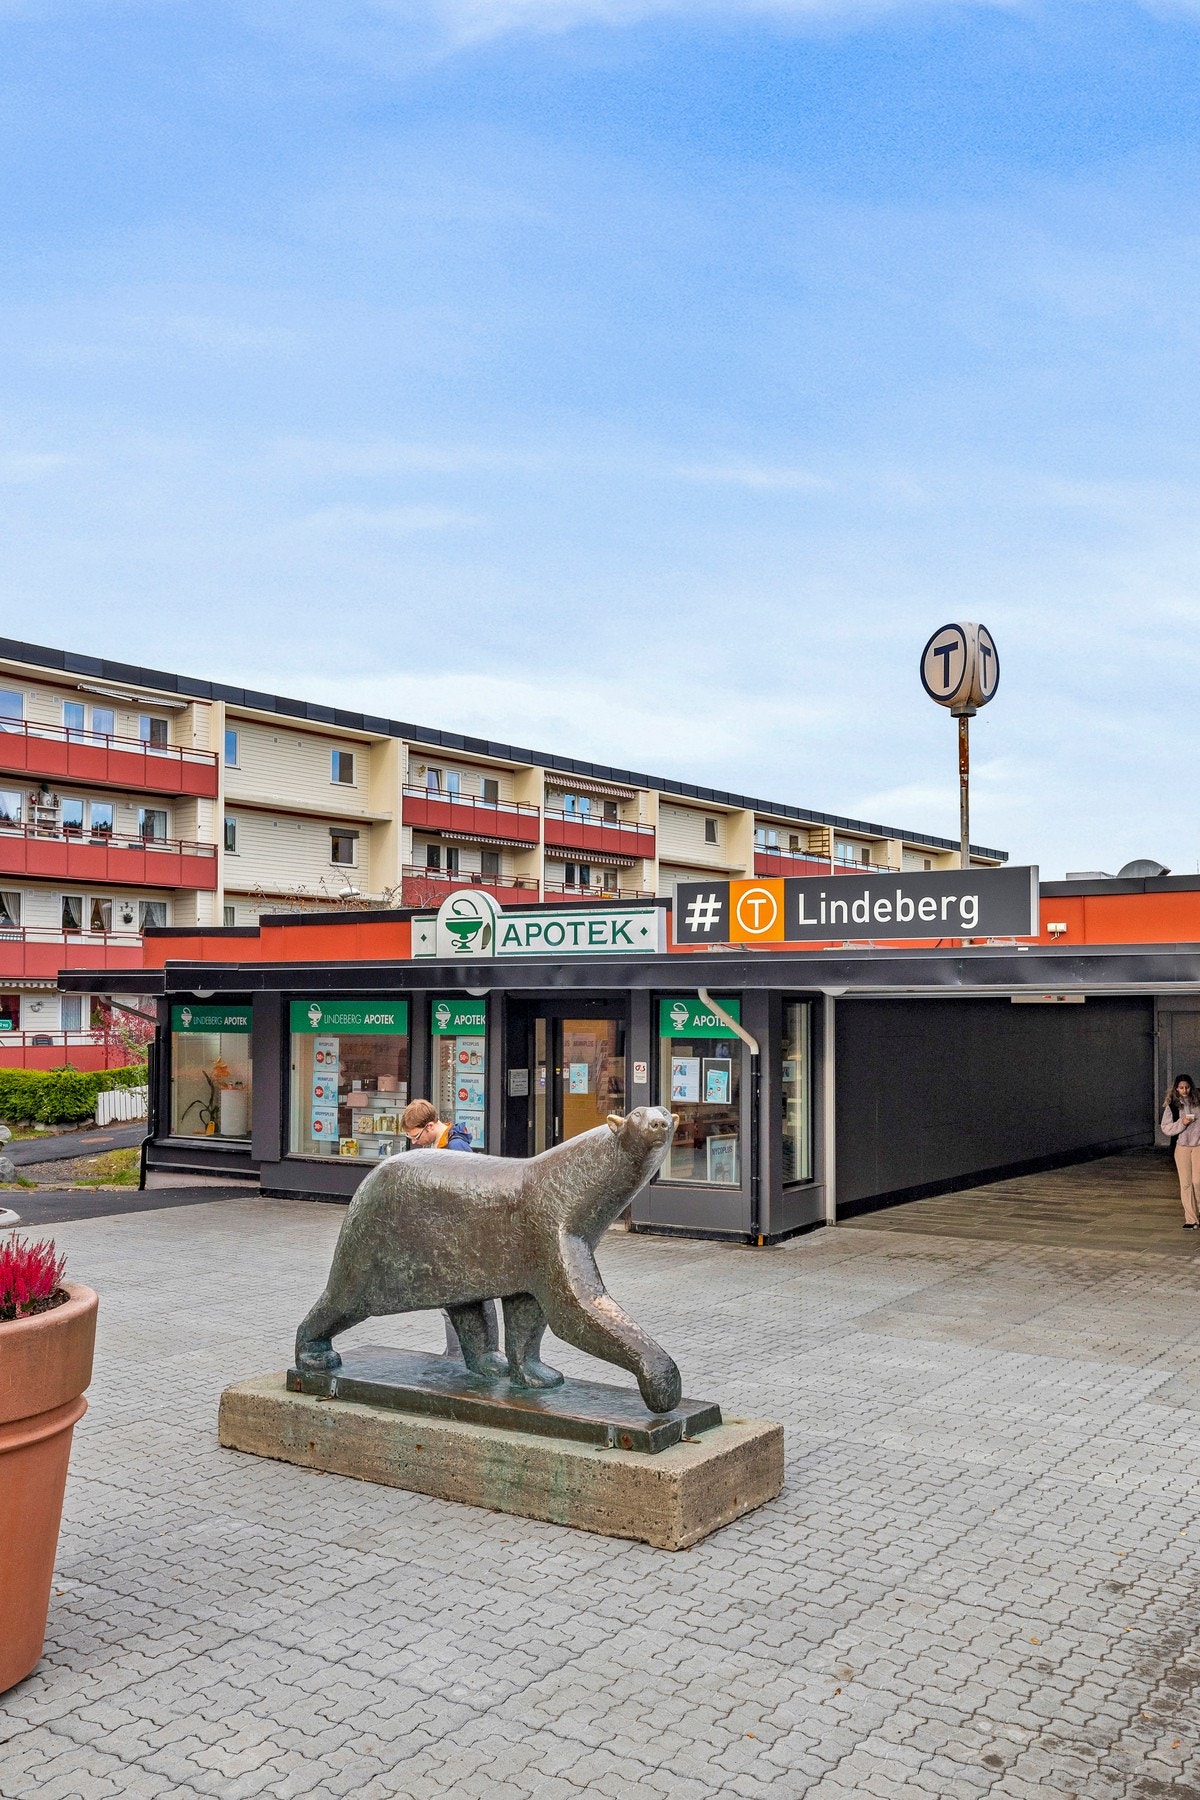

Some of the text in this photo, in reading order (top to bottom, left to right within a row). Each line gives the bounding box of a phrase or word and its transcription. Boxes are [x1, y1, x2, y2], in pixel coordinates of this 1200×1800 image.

[934, 641, 958, 688] T
[980, 642, 991, 689] T
[798, 889, 980, 930] Lindeberg
[501, 920, 634, 947] APOTEK
[193, 1016, 248, 1026] LINDEBERG APOTEK
[323, 1014, 395, 1025] LINDEBERG APOTEK
[453, 1014, 486, 1025] APOTEK
[692, 1015, 733, 1027] APOTE
